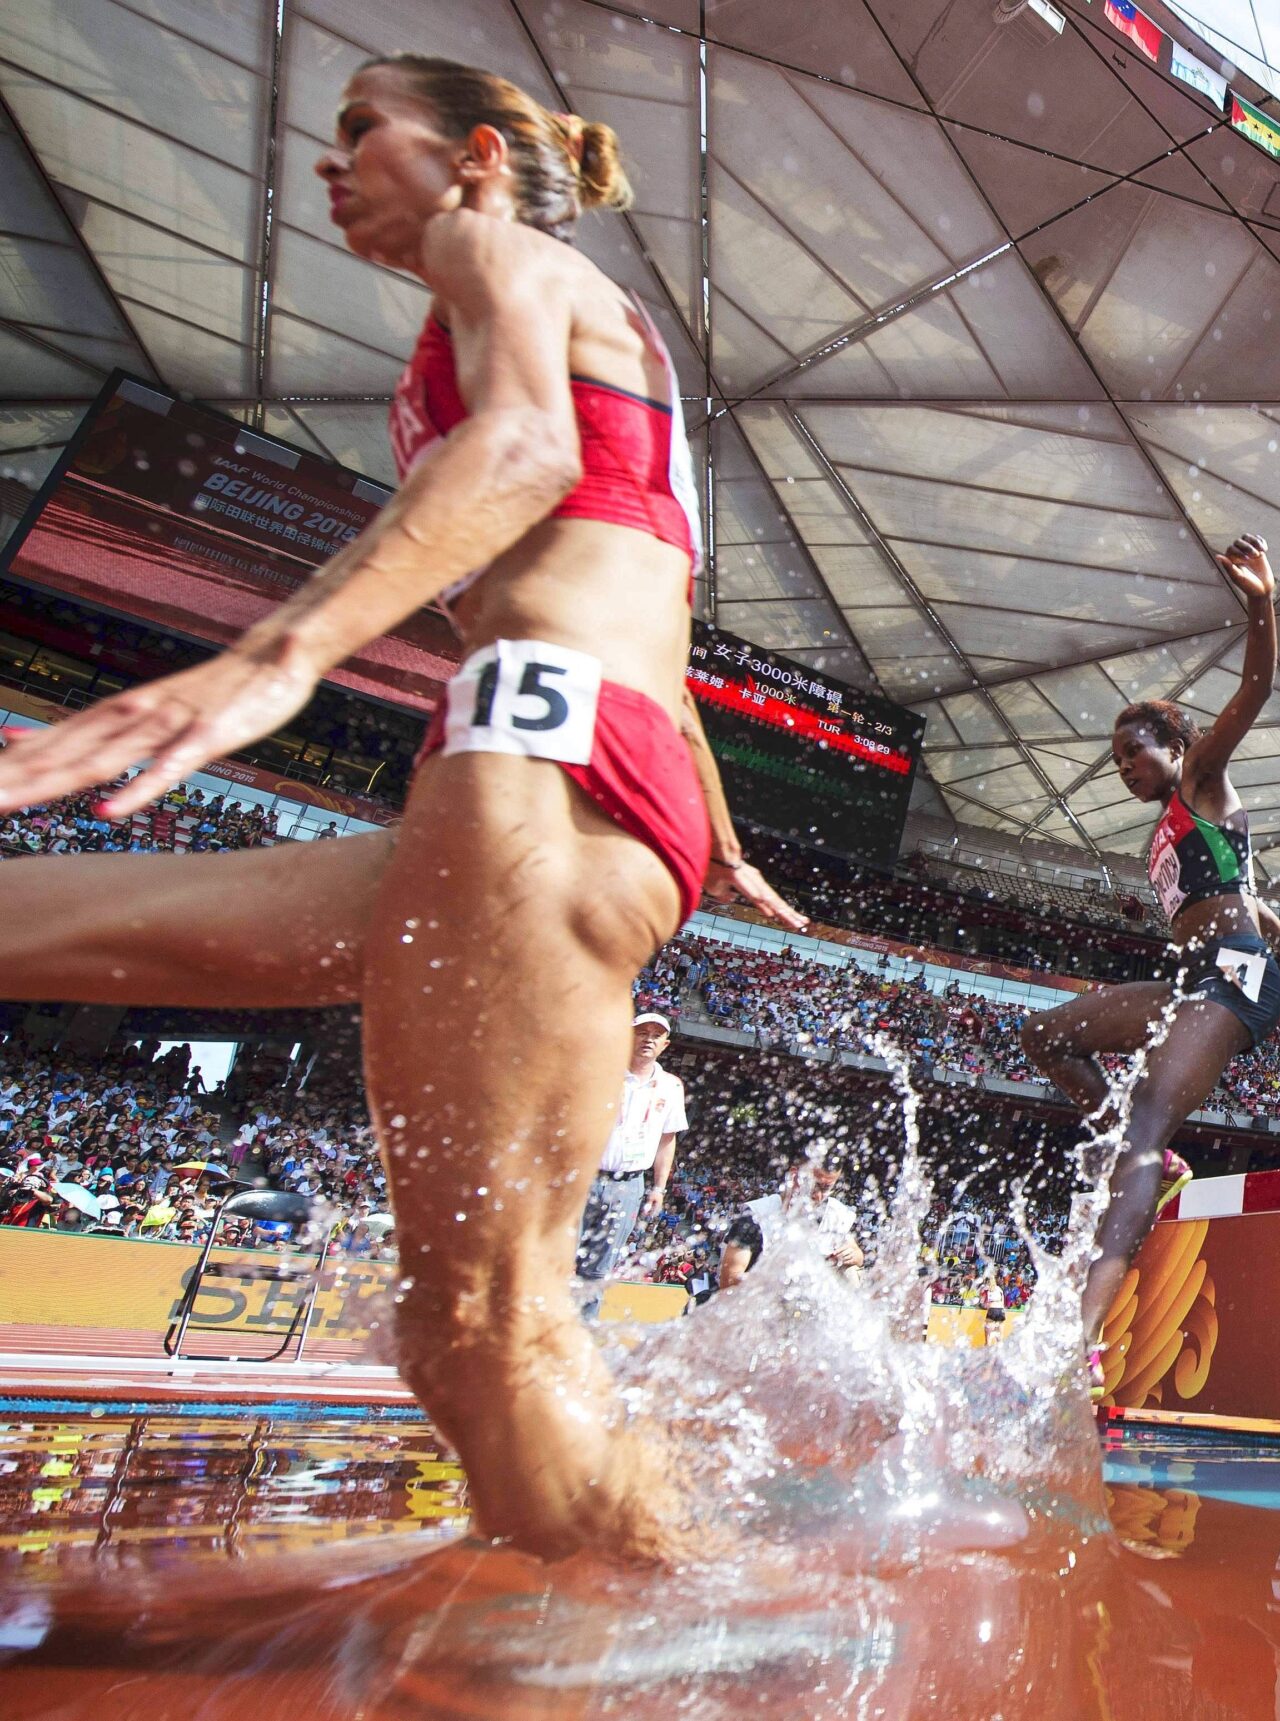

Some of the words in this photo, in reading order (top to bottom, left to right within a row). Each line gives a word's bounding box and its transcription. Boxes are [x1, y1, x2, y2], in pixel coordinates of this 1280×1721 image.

[194, 493, 350, 557] 国际田联世界田径锦标
[203, 472, 304, 521] BEIJING
[303, 512, 362, 543] 2015
[251, 470, 286, 490] World
[287, 485, 367, 524] Championships
[470, 658, 569, 732] 15
[713, 643, 843, 704] 女子3000米障碍
[738, 687, 767, 706] 卡亚
[817, 718, 841, 736] TUR
[874, 721, 893, 736] 2/3
